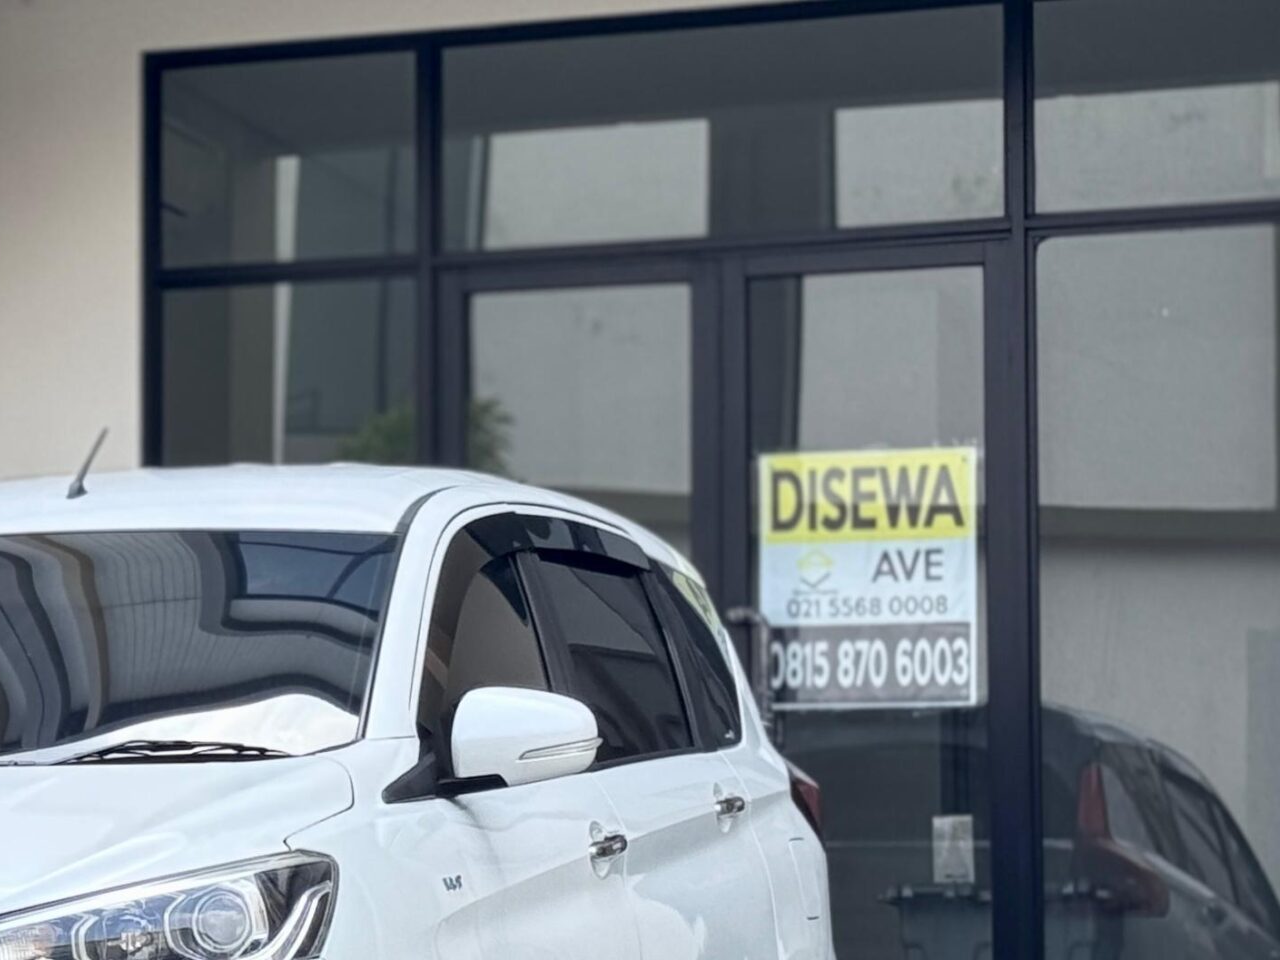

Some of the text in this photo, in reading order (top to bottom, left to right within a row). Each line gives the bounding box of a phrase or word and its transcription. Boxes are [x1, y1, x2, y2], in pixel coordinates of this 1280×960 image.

[771, 465, 965, 532] DISEWA
[872, 548, 944, 583] AVE
[786, 595, 948, 619] 021 5568 0008
[837, 640, 889, 688] 870
[895, 637, 969, 687] 6003
